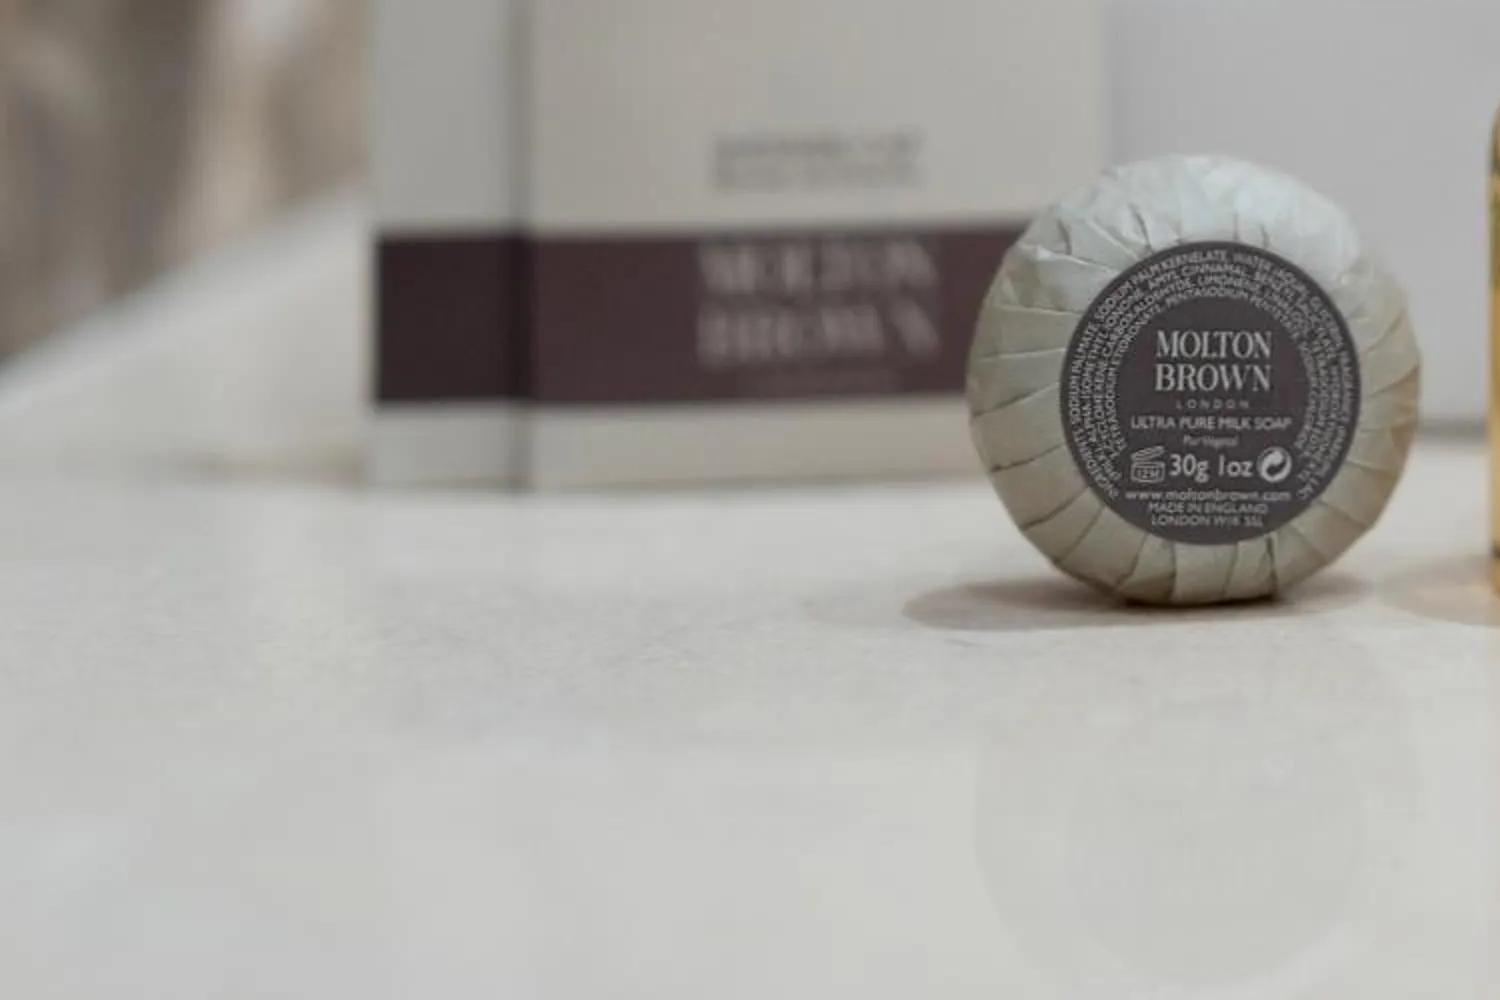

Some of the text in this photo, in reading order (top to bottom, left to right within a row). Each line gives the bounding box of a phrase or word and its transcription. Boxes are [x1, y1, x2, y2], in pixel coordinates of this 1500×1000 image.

[1156, 330, 1271, 359] MOLTON
[1154, 363, 1271, 391] BROWN
[1175, 398, 1250, 410] LONDON
[1131, 415, 1292, 431] ULTRA PURE MILK SOAP
[1169, 453, 1210, 484] 30g
